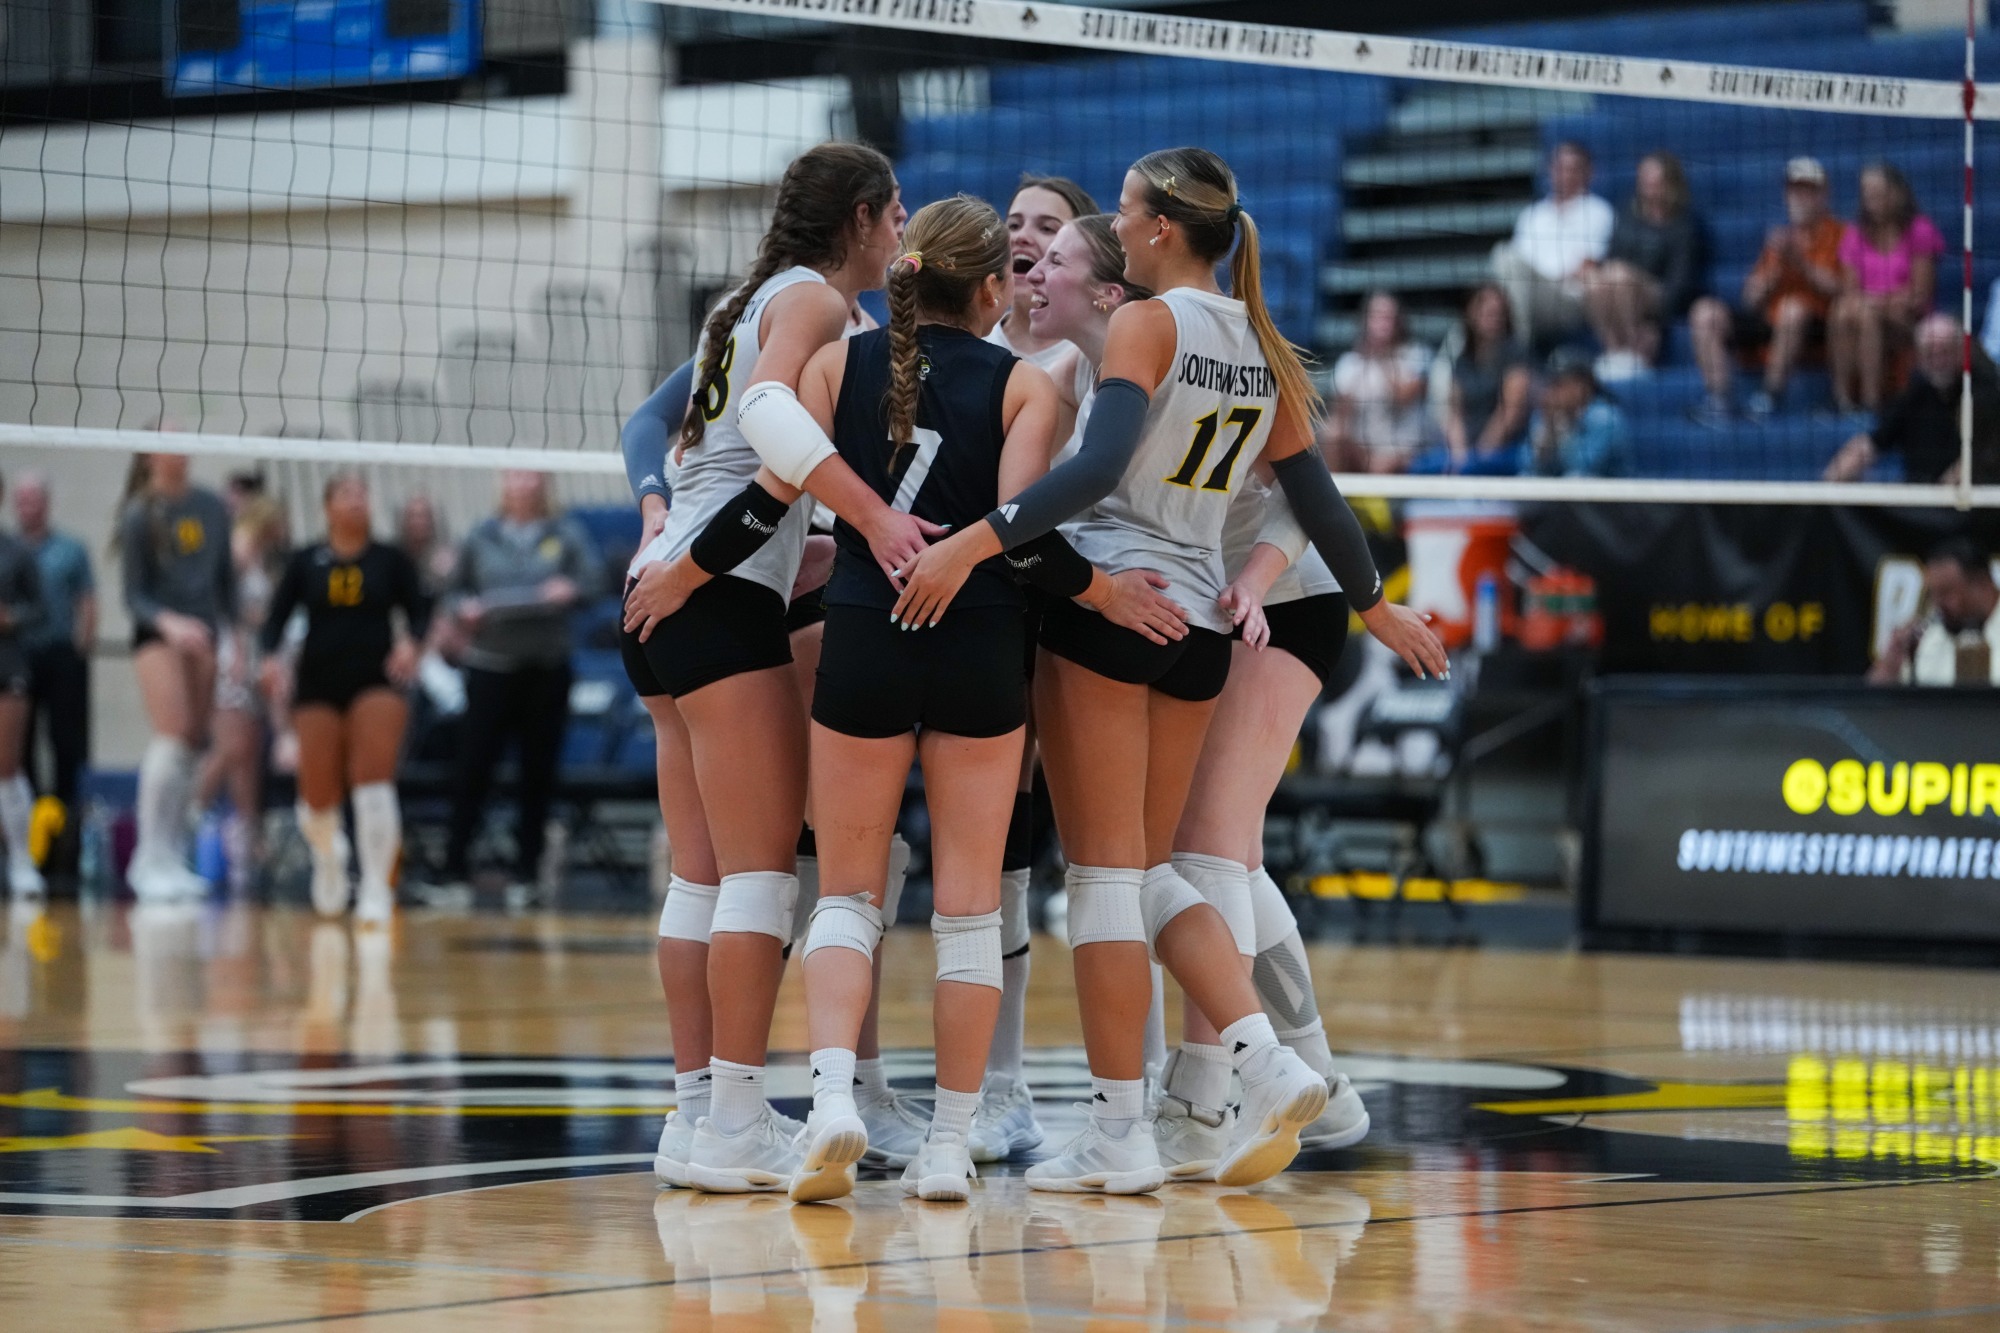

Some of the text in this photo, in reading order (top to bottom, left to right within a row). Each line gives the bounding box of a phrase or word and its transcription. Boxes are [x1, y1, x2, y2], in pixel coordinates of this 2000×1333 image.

[1081, 12, 1314, 58] SOUTHWESTERN PIRATES
[1409, 42, 1546, 78] SOUTHWESTERN
[887, 425, 943, 514] 7
[1164, 405, 1263, 492] 17
[1649, 602, 1823, 642] HOME OF
